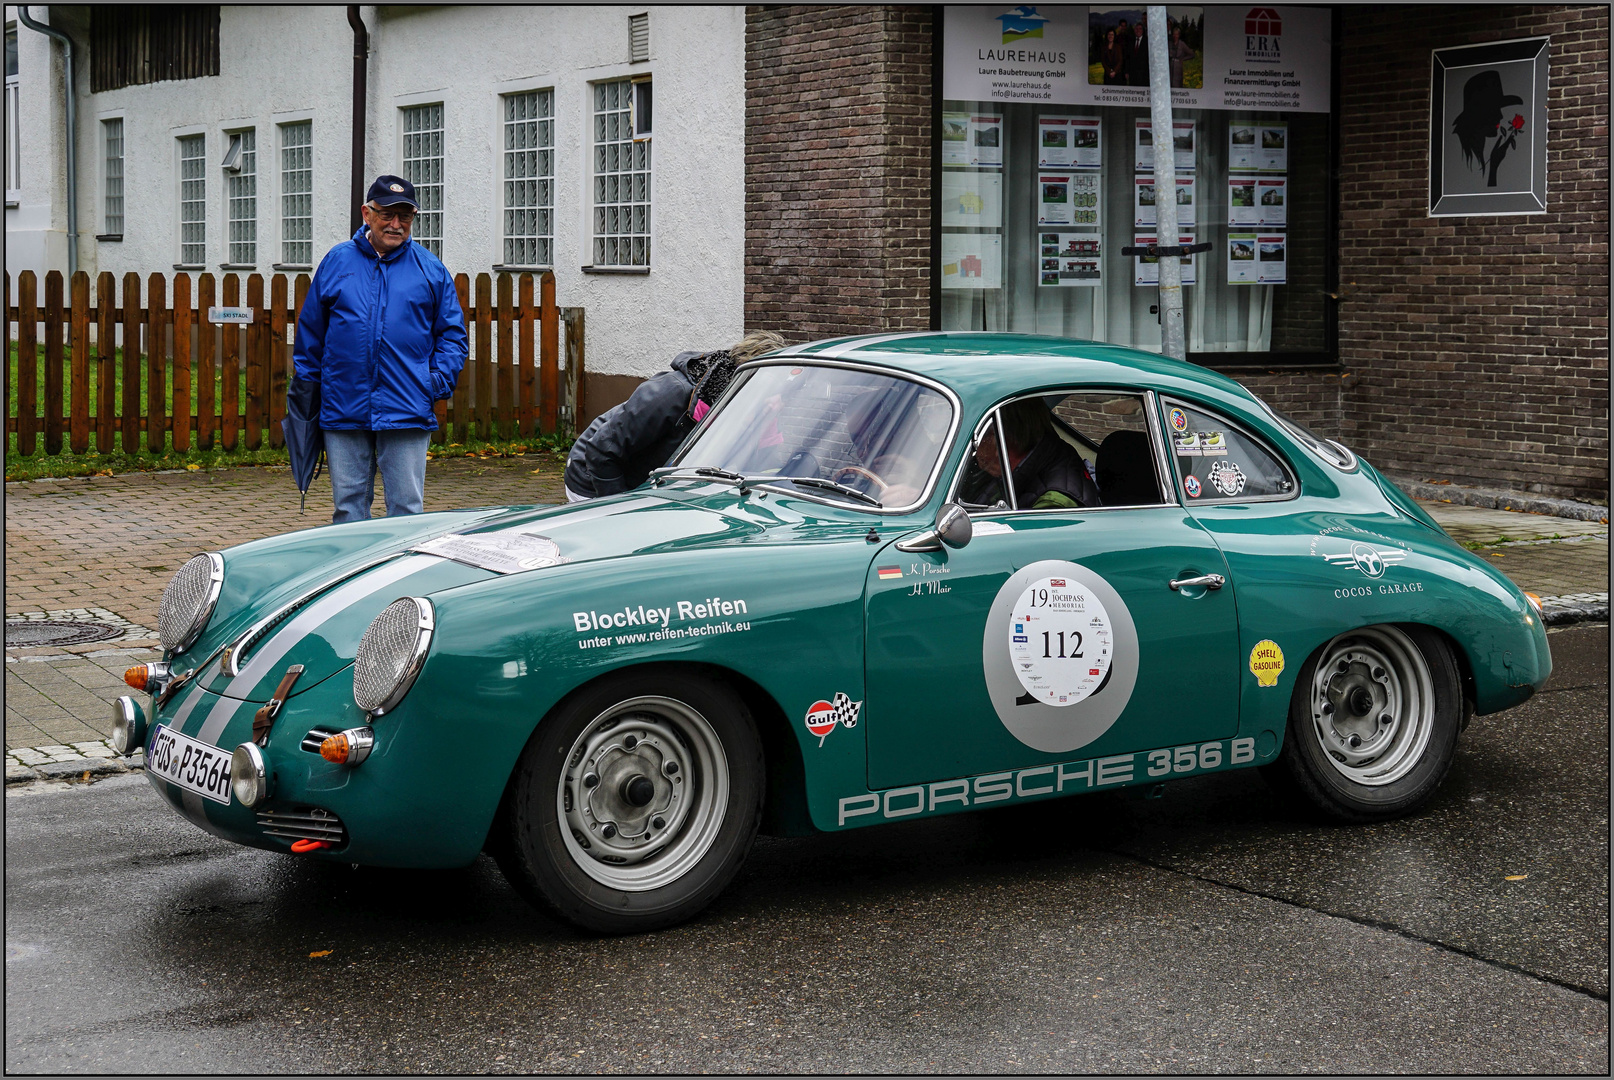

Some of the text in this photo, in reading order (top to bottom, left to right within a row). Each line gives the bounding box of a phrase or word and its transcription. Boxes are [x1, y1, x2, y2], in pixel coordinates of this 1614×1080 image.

[1246, 36, 1280, 51] ERA
[978, 48, 1066, 64] LAUREHAUS
[979, 67, 1066, 78] Laure Baubetreuung GmbH
[1247, 69, 1281, 78] Immobilien
[992, 80, 1051, 90] www.laurehaus.de
[1224, 78, 1301, 88] Finanzvermittlungs GmbH
[991, 90, 1051, 99] info@laurehaus.de
[1101, 88, 1146, 96] Schimmelreiterweg
[1224, 90, 1300, 99] www.laure-immobilien.de
[1224, 98, 1300, 108] info@laure-immobilien.de
[906, 563, 951, 576] K. Porsche
[908, 580, 952, 597] H. Mair
[1334, 582, 1424, 599] COCOS GARAGE
[1030, 588, 1052, 608] 19.
[1052, 594, 1085, 602] JOCHPASS
[573, 597, 748, 632] Blockley Reifen
[578, 621, 751, 650] unter www.reifen-technik.eu
[1041, 630, 1084, 659] 112
[1257, 649, 1276, 660] SHELL
[1253, 660, 1281, 671] GASOLINE
[807, 712, 837, 725] Gulf
[152, 733, 232, 798] FÜS P356H
[838, 737, 1255, 826] PORSCHE 356 B
